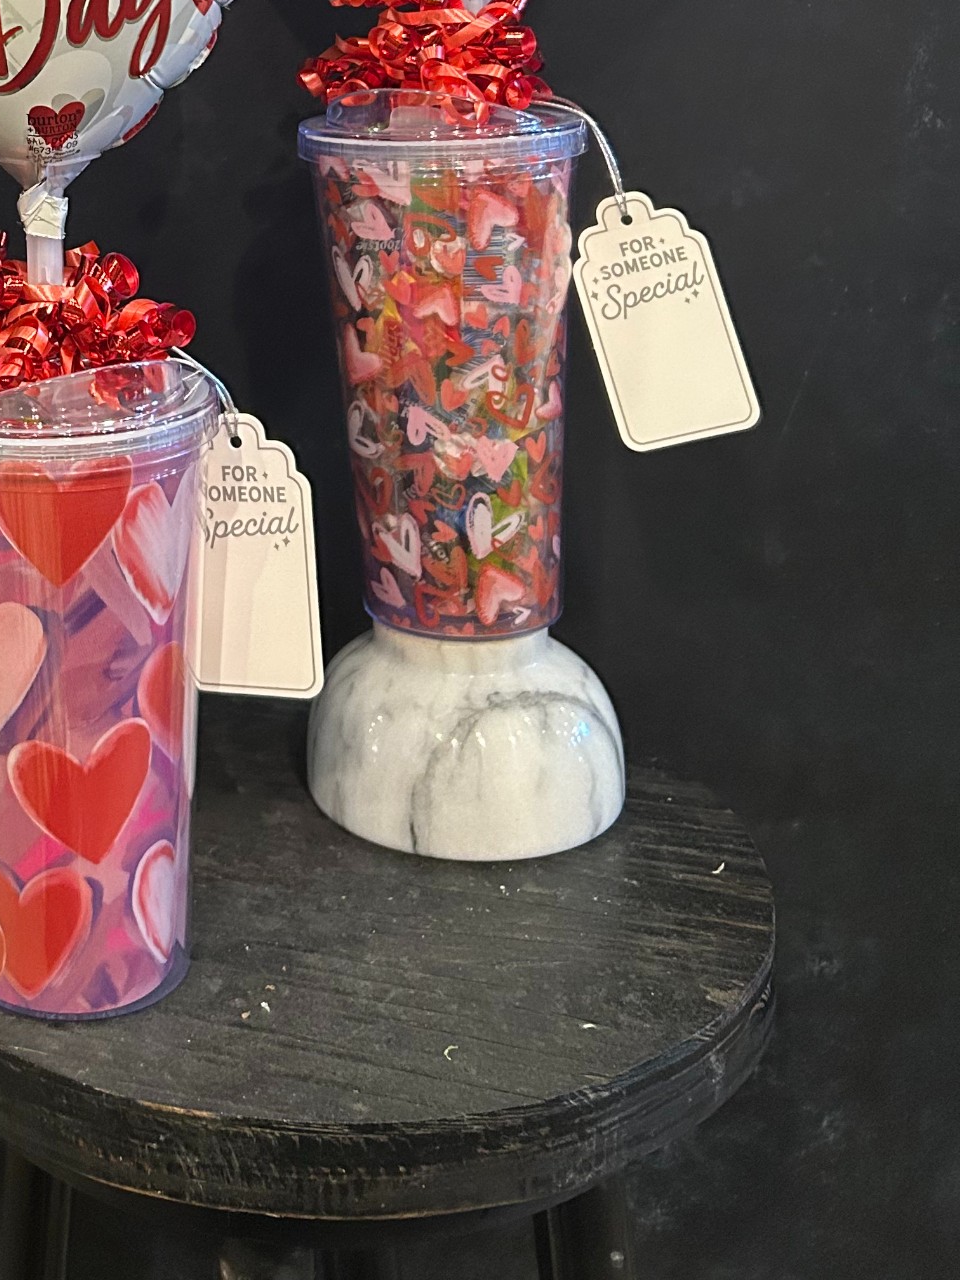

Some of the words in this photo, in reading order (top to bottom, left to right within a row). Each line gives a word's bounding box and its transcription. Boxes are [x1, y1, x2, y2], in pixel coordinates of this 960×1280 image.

[27, 111, 77, 125] burton
[619, 235, 655, 257] FOR
[600, 246, 688, 281] SOMEONE
[601, 261, 705, 320] Special
[221, 465, 258, 482] FOR
[208, 485, 287, 503] OMEONE
